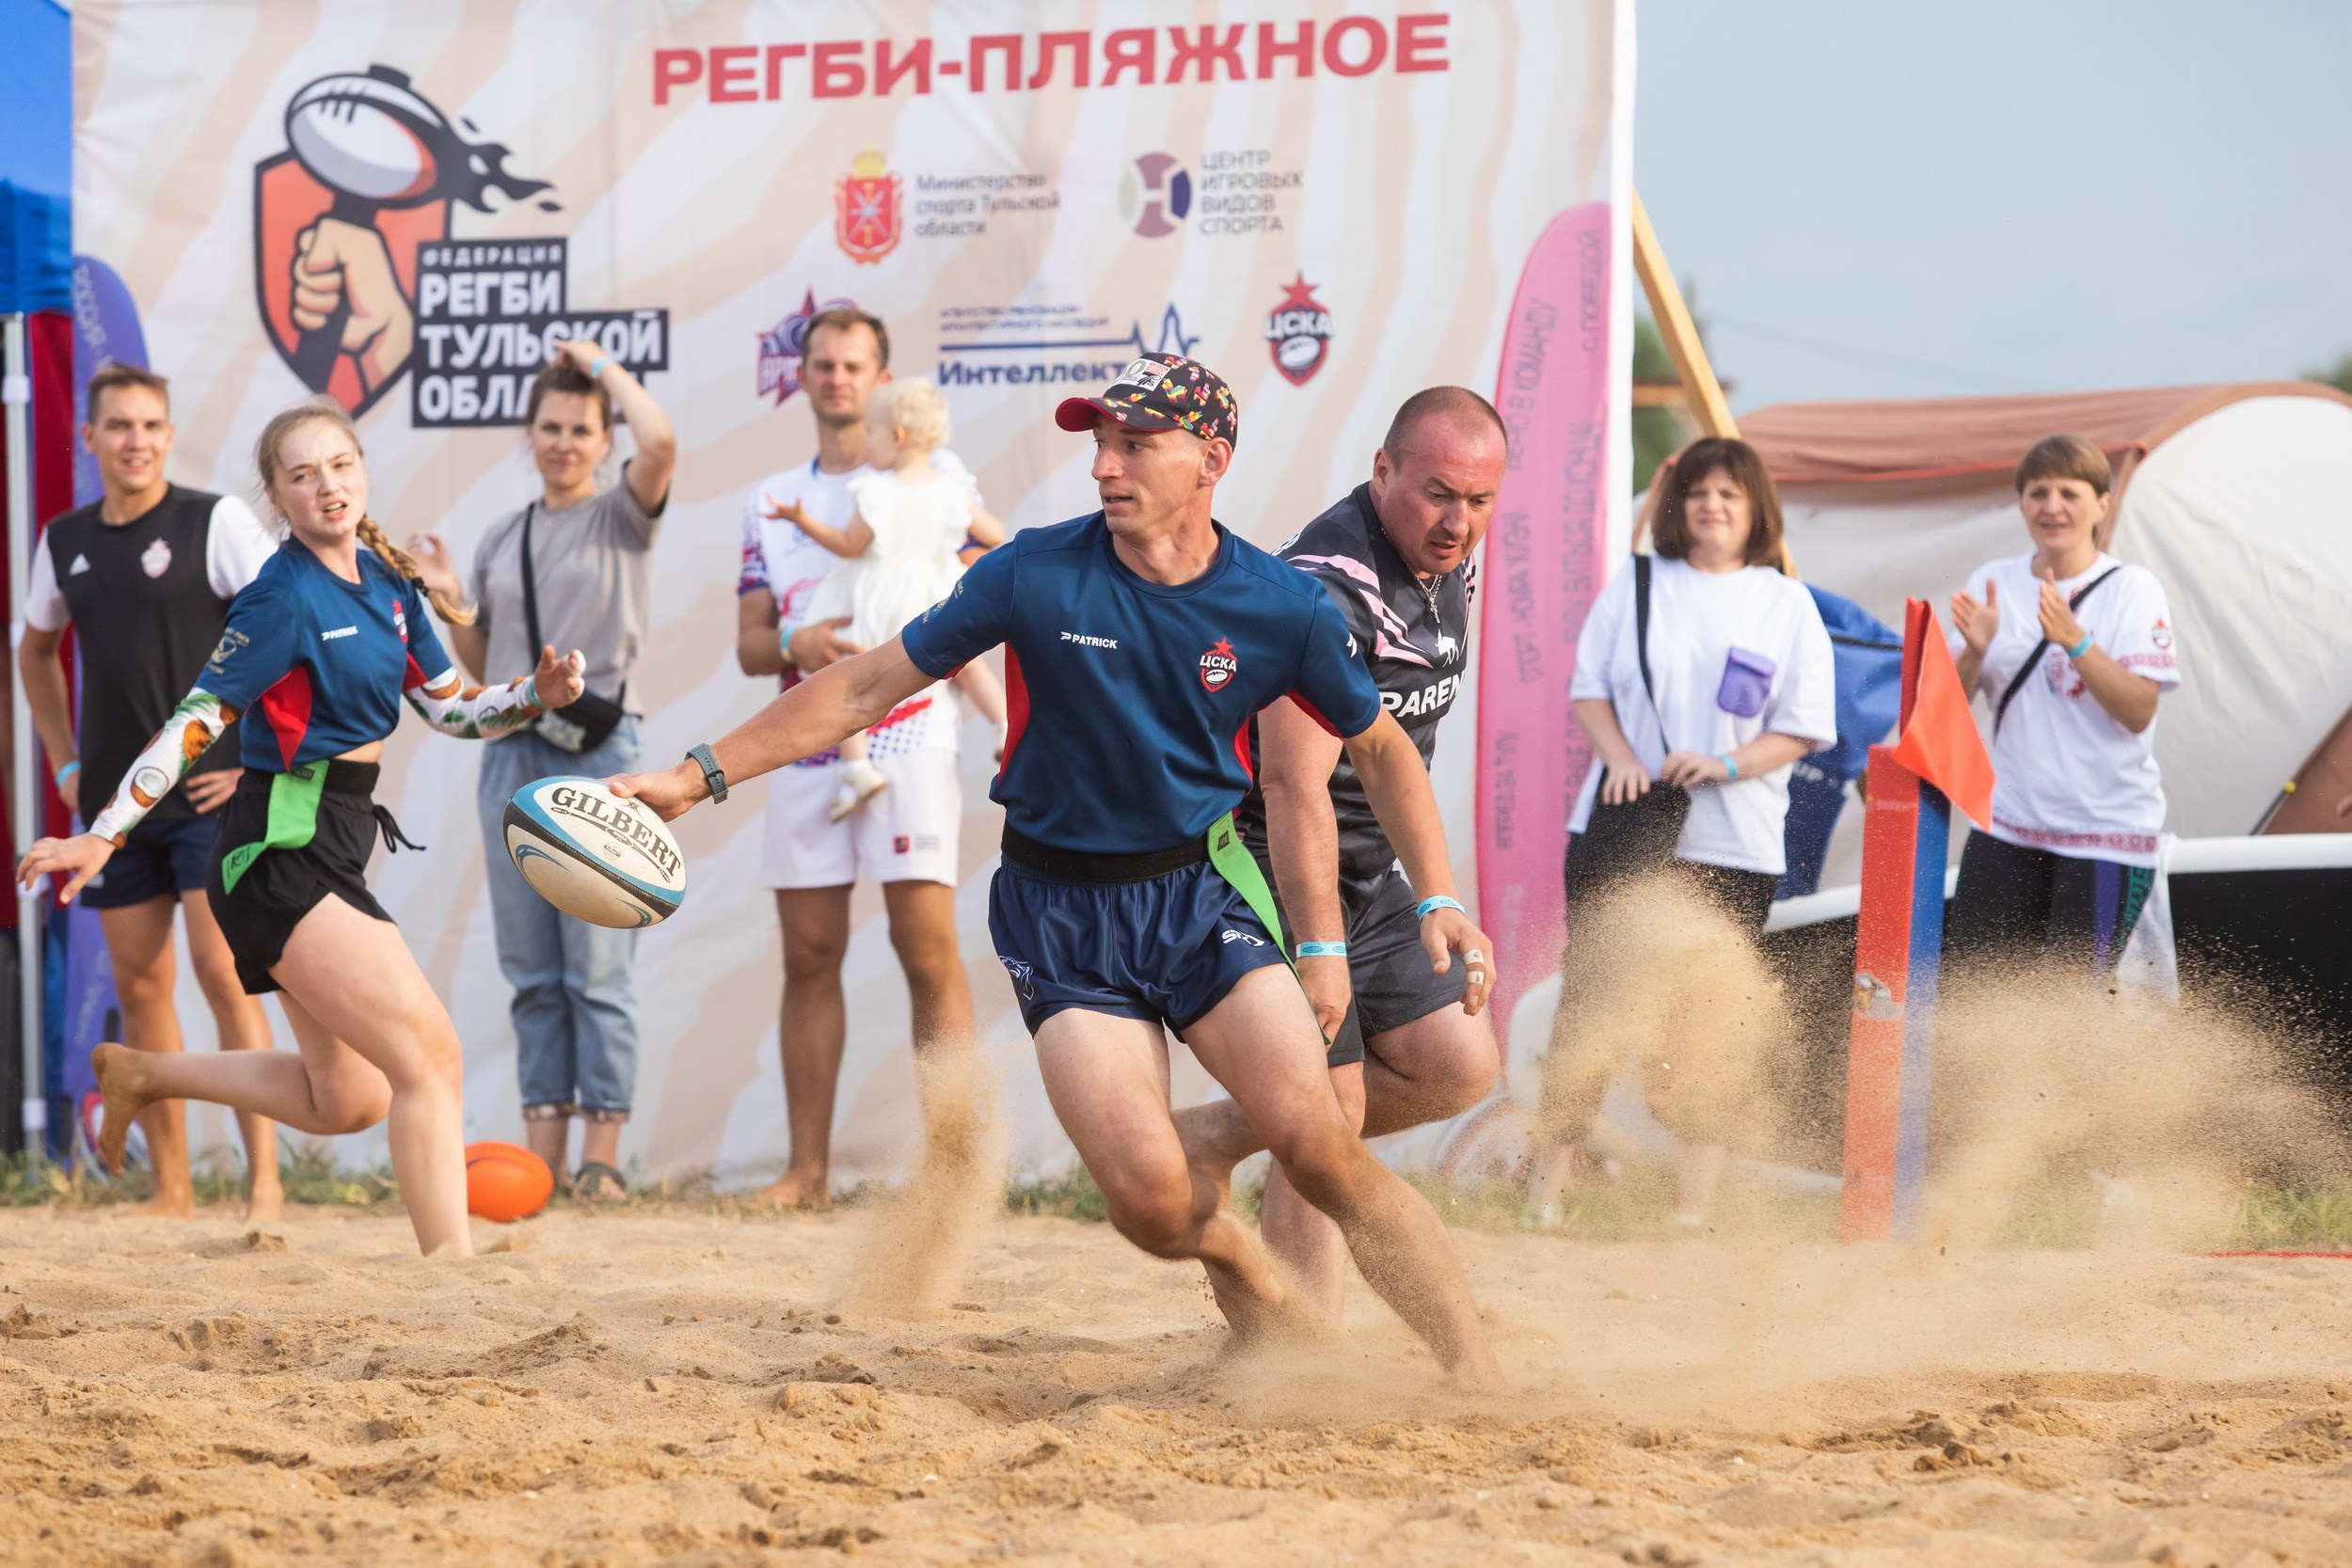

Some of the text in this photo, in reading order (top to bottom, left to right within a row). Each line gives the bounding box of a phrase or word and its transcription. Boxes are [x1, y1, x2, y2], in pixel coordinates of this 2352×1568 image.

[653, 13, 1450, 105] РЕГБИ-ПЛЯЖНОЕ
[1200, 150, 1271, 170] ЦЕНТР
[1199, 216, 1284, 235] СПОРТА
[422, 245, 563, 267] ФЕДЕРАЦИЯ
[420, 271, 562, 317] РЕГБИ
[1265, 311, 1334, 339] ЦСКА
[1073, 634, 1118, 649] PATRICK
[1200, 655, 1236, 672] ЦСКА
[552, 787, 681, 877] GILBERT
